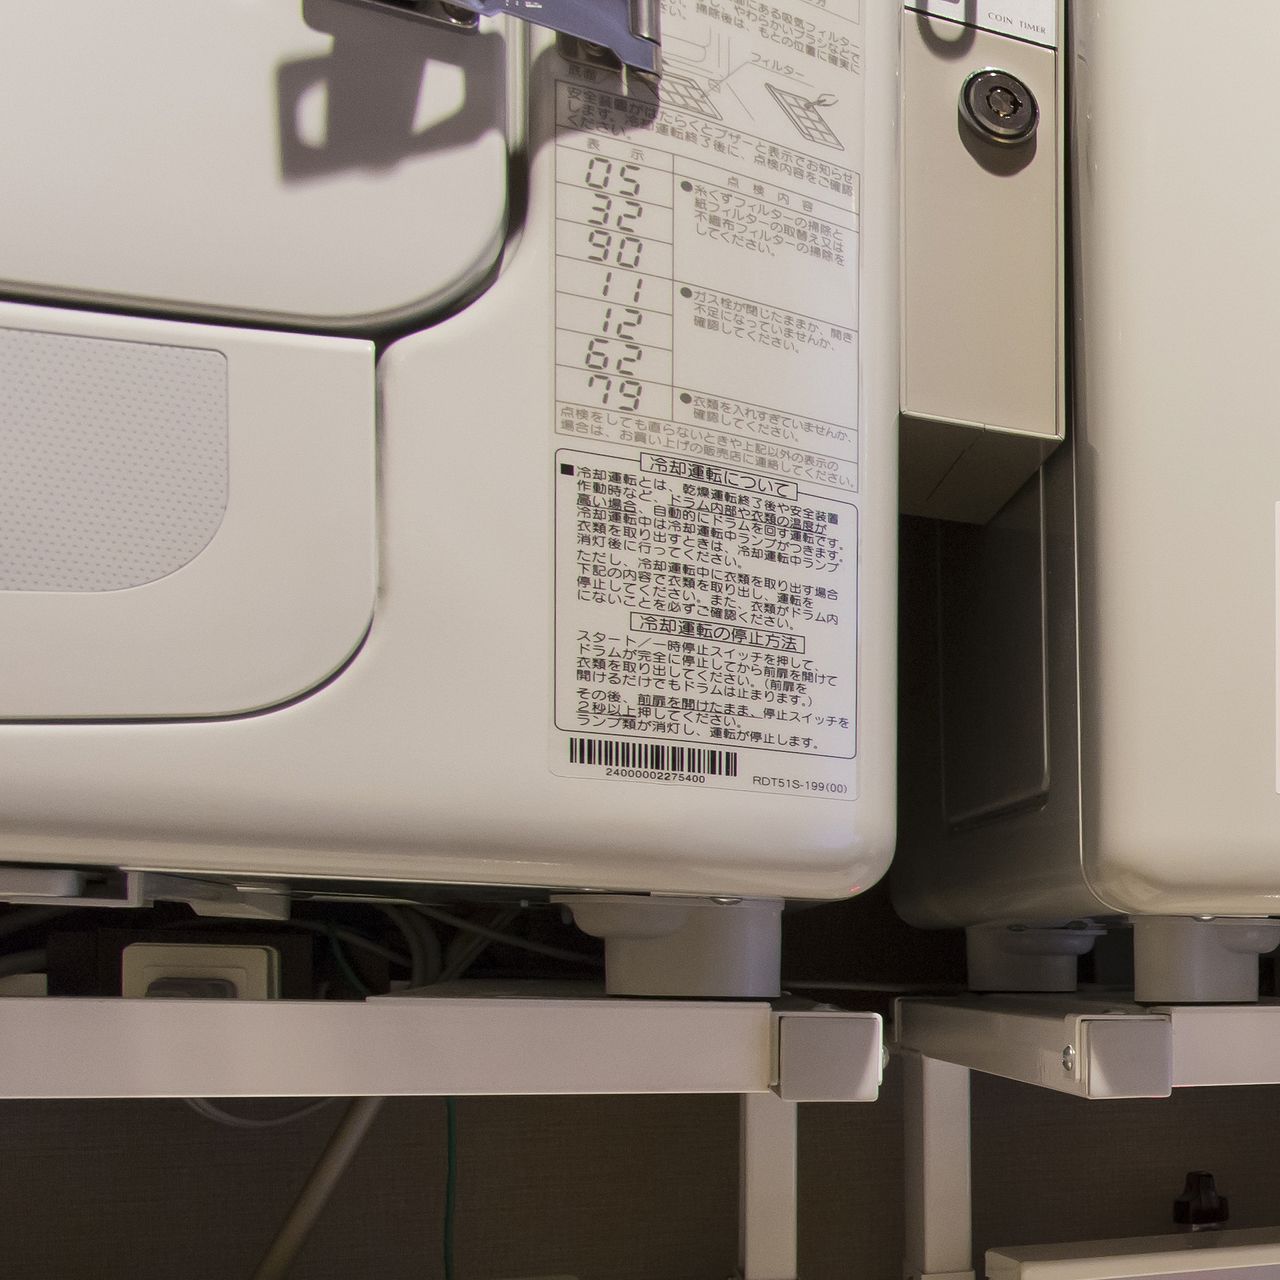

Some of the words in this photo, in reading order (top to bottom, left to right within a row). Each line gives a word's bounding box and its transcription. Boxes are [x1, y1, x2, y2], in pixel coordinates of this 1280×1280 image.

[988, 12, 1013, 25] COIN
[1019, 20, 1046, 35] TIMER
[751, 53, 806, 78] フィルター
[585, 156, 640, 197] 05
[587, 193, 643, 233] 32
[587, 229, 643, 269] 90
[602, 271, 643, 303] 11
[602, 307, 643, 341] 12
[585, 337, 643, 377] 62
[587, 374, 643, 412] 79
[650, 456, 791, 499] 冷却運転について
[576, 533, 743, 570] 消灯後に行ってください。
[640, 615, 798, 651] 冷却運転の停止方法
[752, 775, 848, 794] RDT51S-199(00)
